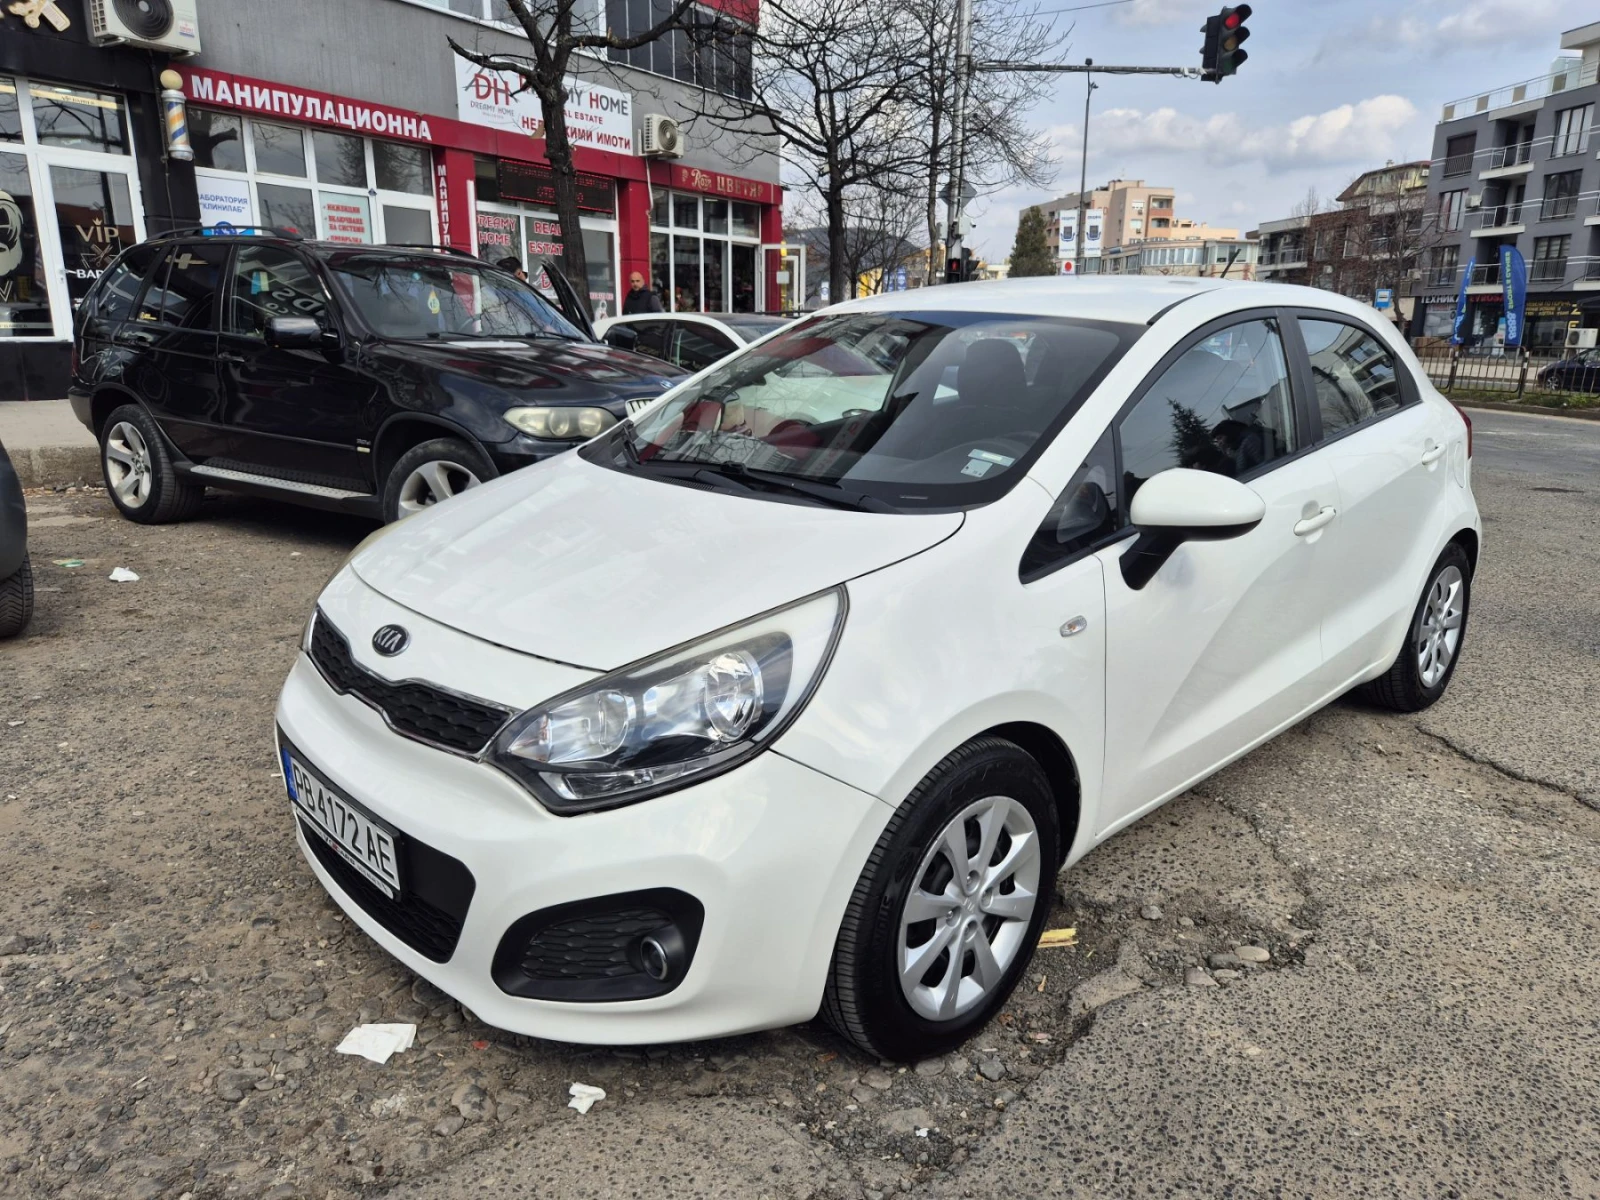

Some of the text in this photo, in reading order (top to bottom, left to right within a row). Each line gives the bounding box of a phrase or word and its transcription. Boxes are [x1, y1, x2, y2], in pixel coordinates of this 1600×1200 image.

[191, 75, 432, 141] МАНИПУЛАЦИОННА
[589, 91, 629, 116] HOME
[574, 112, 603, 125] ESTATE
[596, 132, 631, 150] ИМОТИ
[199, 193, 248, 205] АБОРАТОРИЯ
[477, 215, 517, 232] REAMY
[75, 224, 119, 243] VIP
[479, 231, 511, 247] HOME
[528, 241, 564, 257] ESTAT
[374, 626, 402, 652] KIA
